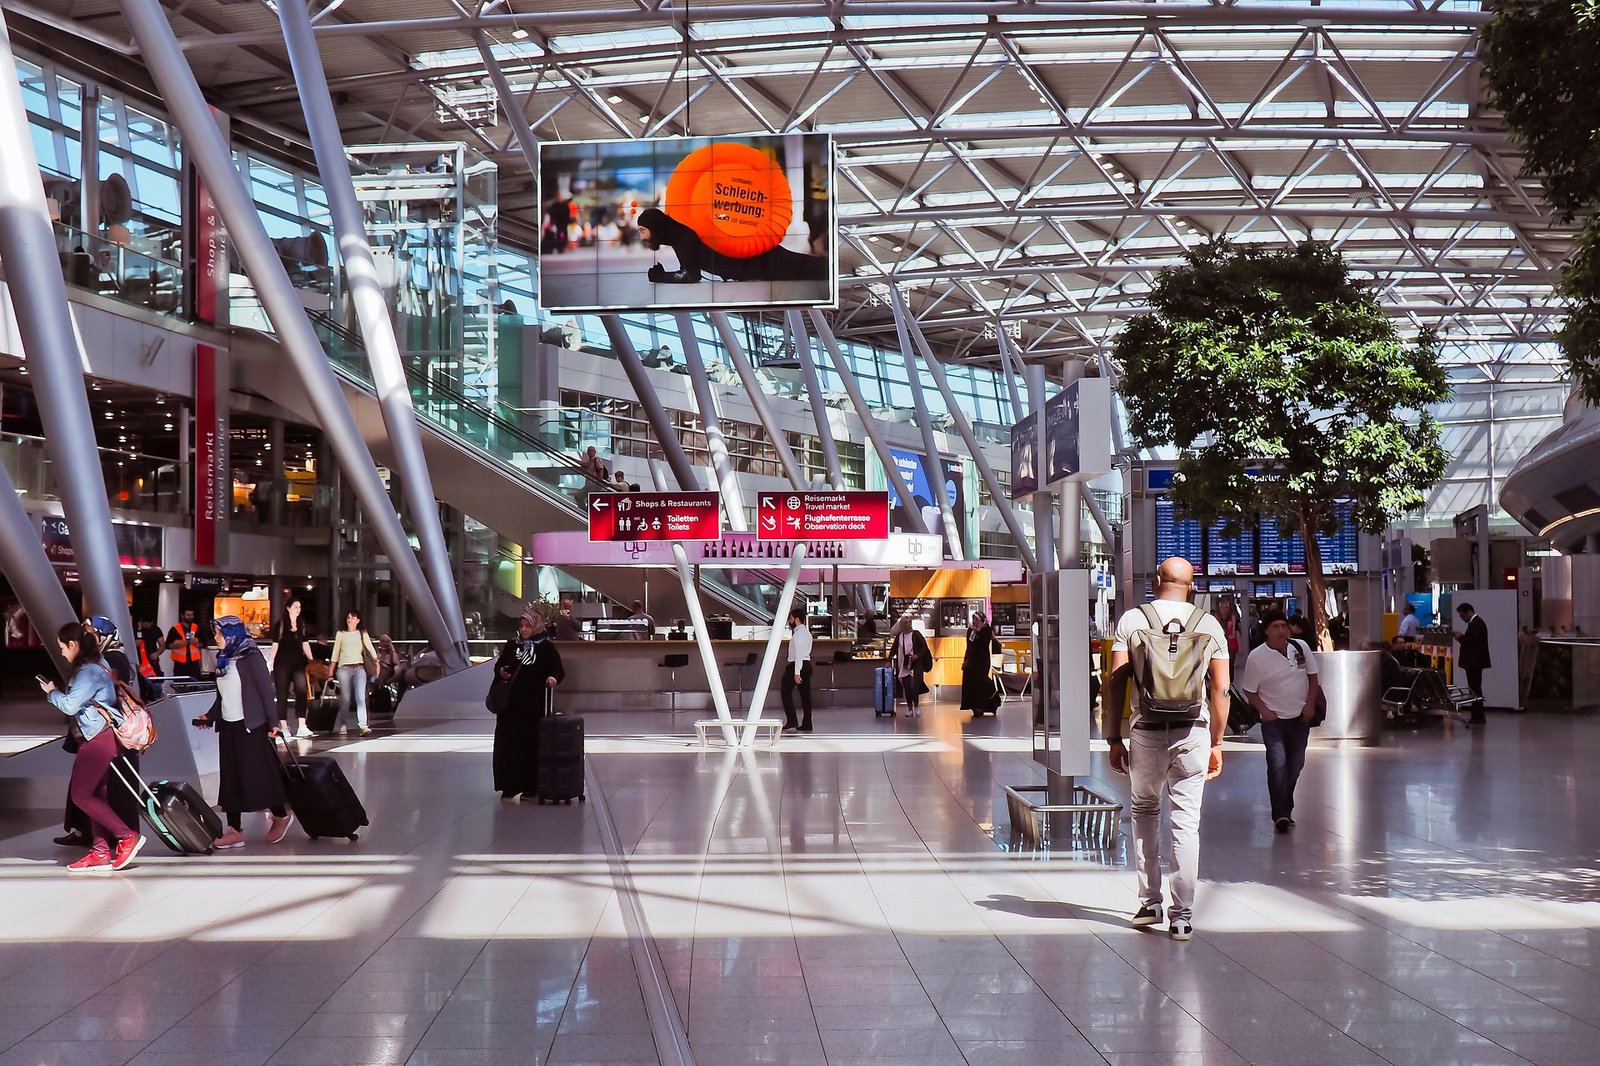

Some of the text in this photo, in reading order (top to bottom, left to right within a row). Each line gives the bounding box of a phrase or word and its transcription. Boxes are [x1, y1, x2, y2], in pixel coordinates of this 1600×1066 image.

[715, 182, 768, 203] Schleich-
[713, 199, 766, 218] werbung:
[207, 215, 216, 226] &
[207, 231, 217, 278] Shops
[205, 432, 214, 520] Reisemarkt
[804, 494, 846, 502] Reisemarkt
[635, 499, 659, 509] Shops
[667, 499, 712, 507] Restaurants
[804, 503, 851, 511] Travel market
[667, 514, 699, 522] Toiletten
[804, 514, 871, 524] Flughafenterrasse
[667, 523, 690, 531] Toilets
[804, 522, 866, 530] Observation deck
